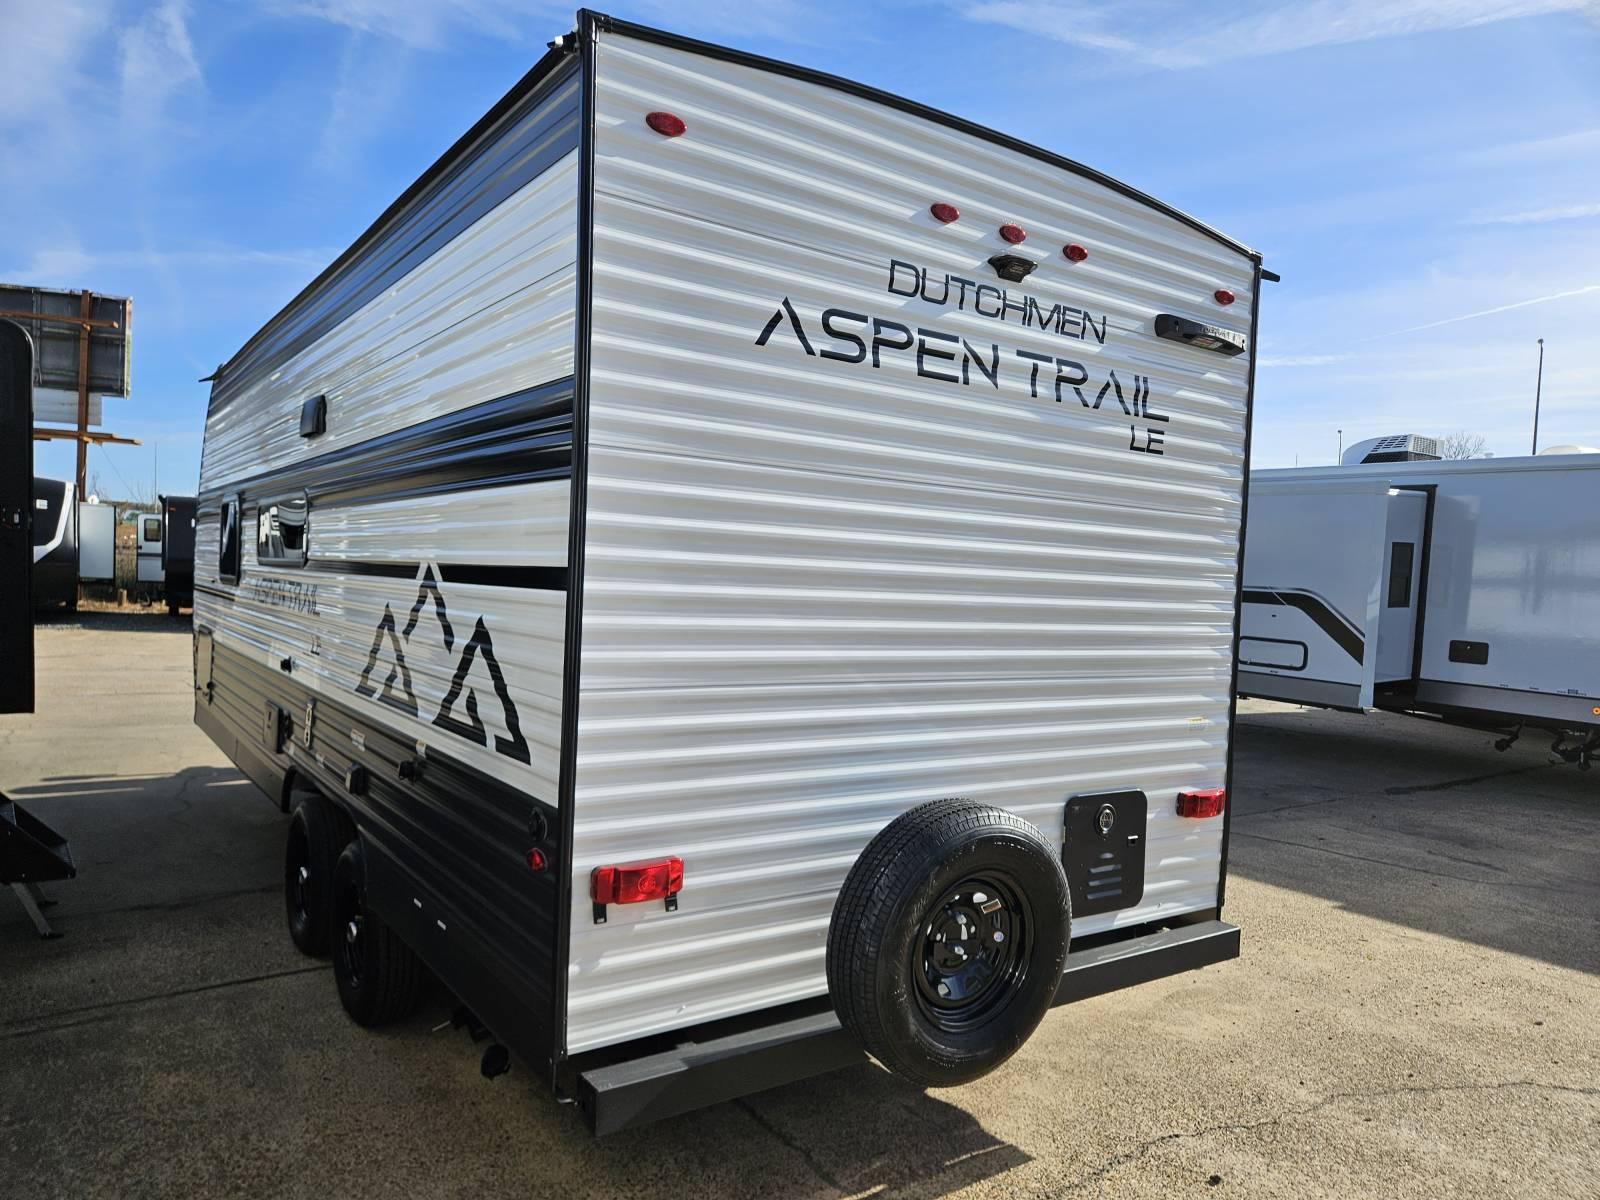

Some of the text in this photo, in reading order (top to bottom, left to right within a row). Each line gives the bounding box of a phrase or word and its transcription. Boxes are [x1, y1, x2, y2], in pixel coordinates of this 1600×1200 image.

[887, 258, 1107, 345] DUTCHMEN
[754, 295, 1170, 423] ASPEN TRAIL
[1129, 424, 1166, 456] LE
[287, 580, 321, 617] TRAIL
